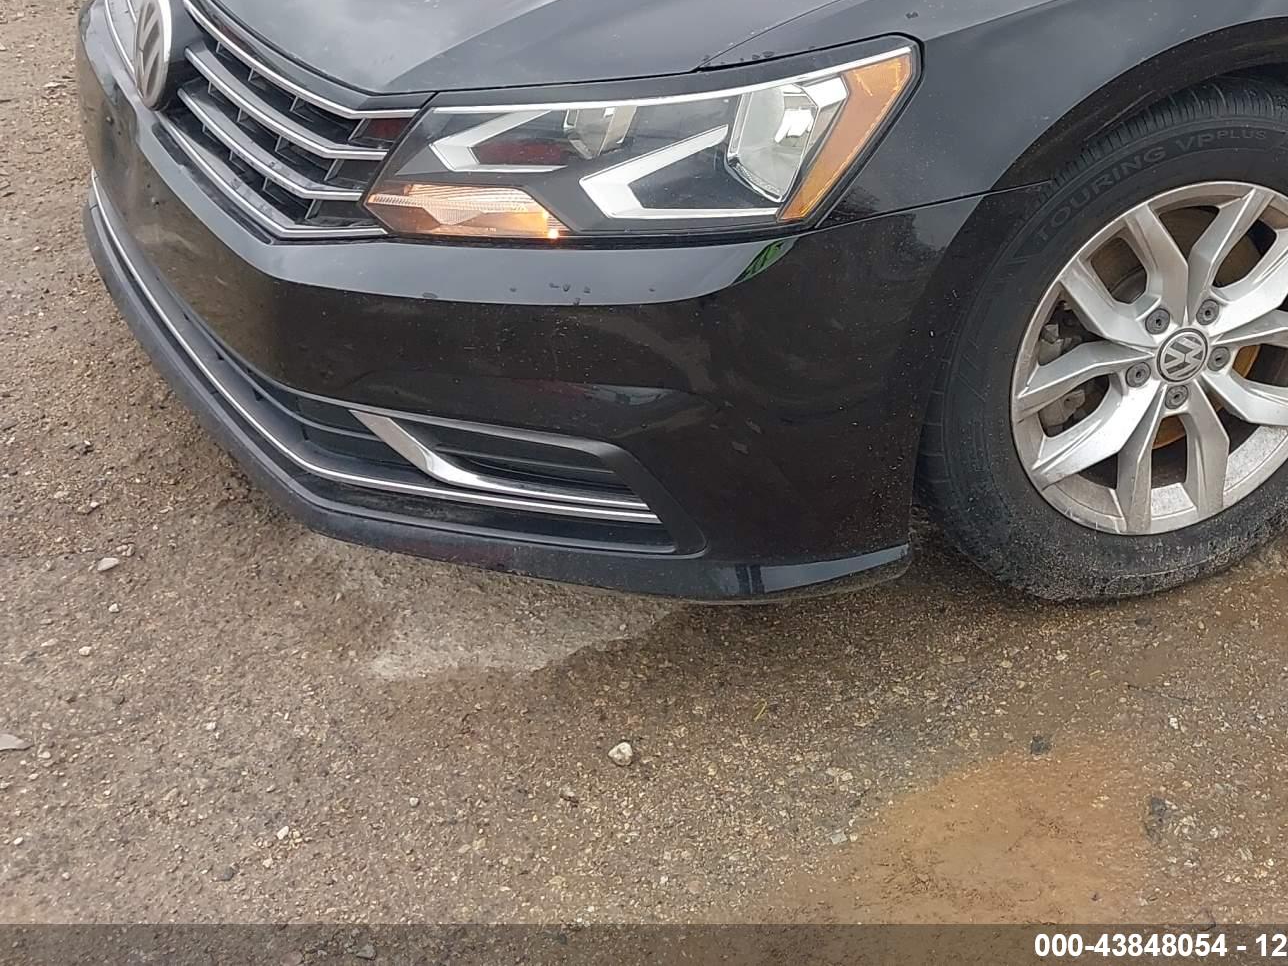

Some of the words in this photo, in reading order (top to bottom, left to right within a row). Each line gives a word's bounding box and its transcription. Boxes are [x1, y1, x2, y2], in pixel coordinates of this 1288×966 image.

[1036, 145, 1168, 241] TOURING
[1175, 131, 1218, 153] VP
[1216, 129, 1268, 141] PLUS
